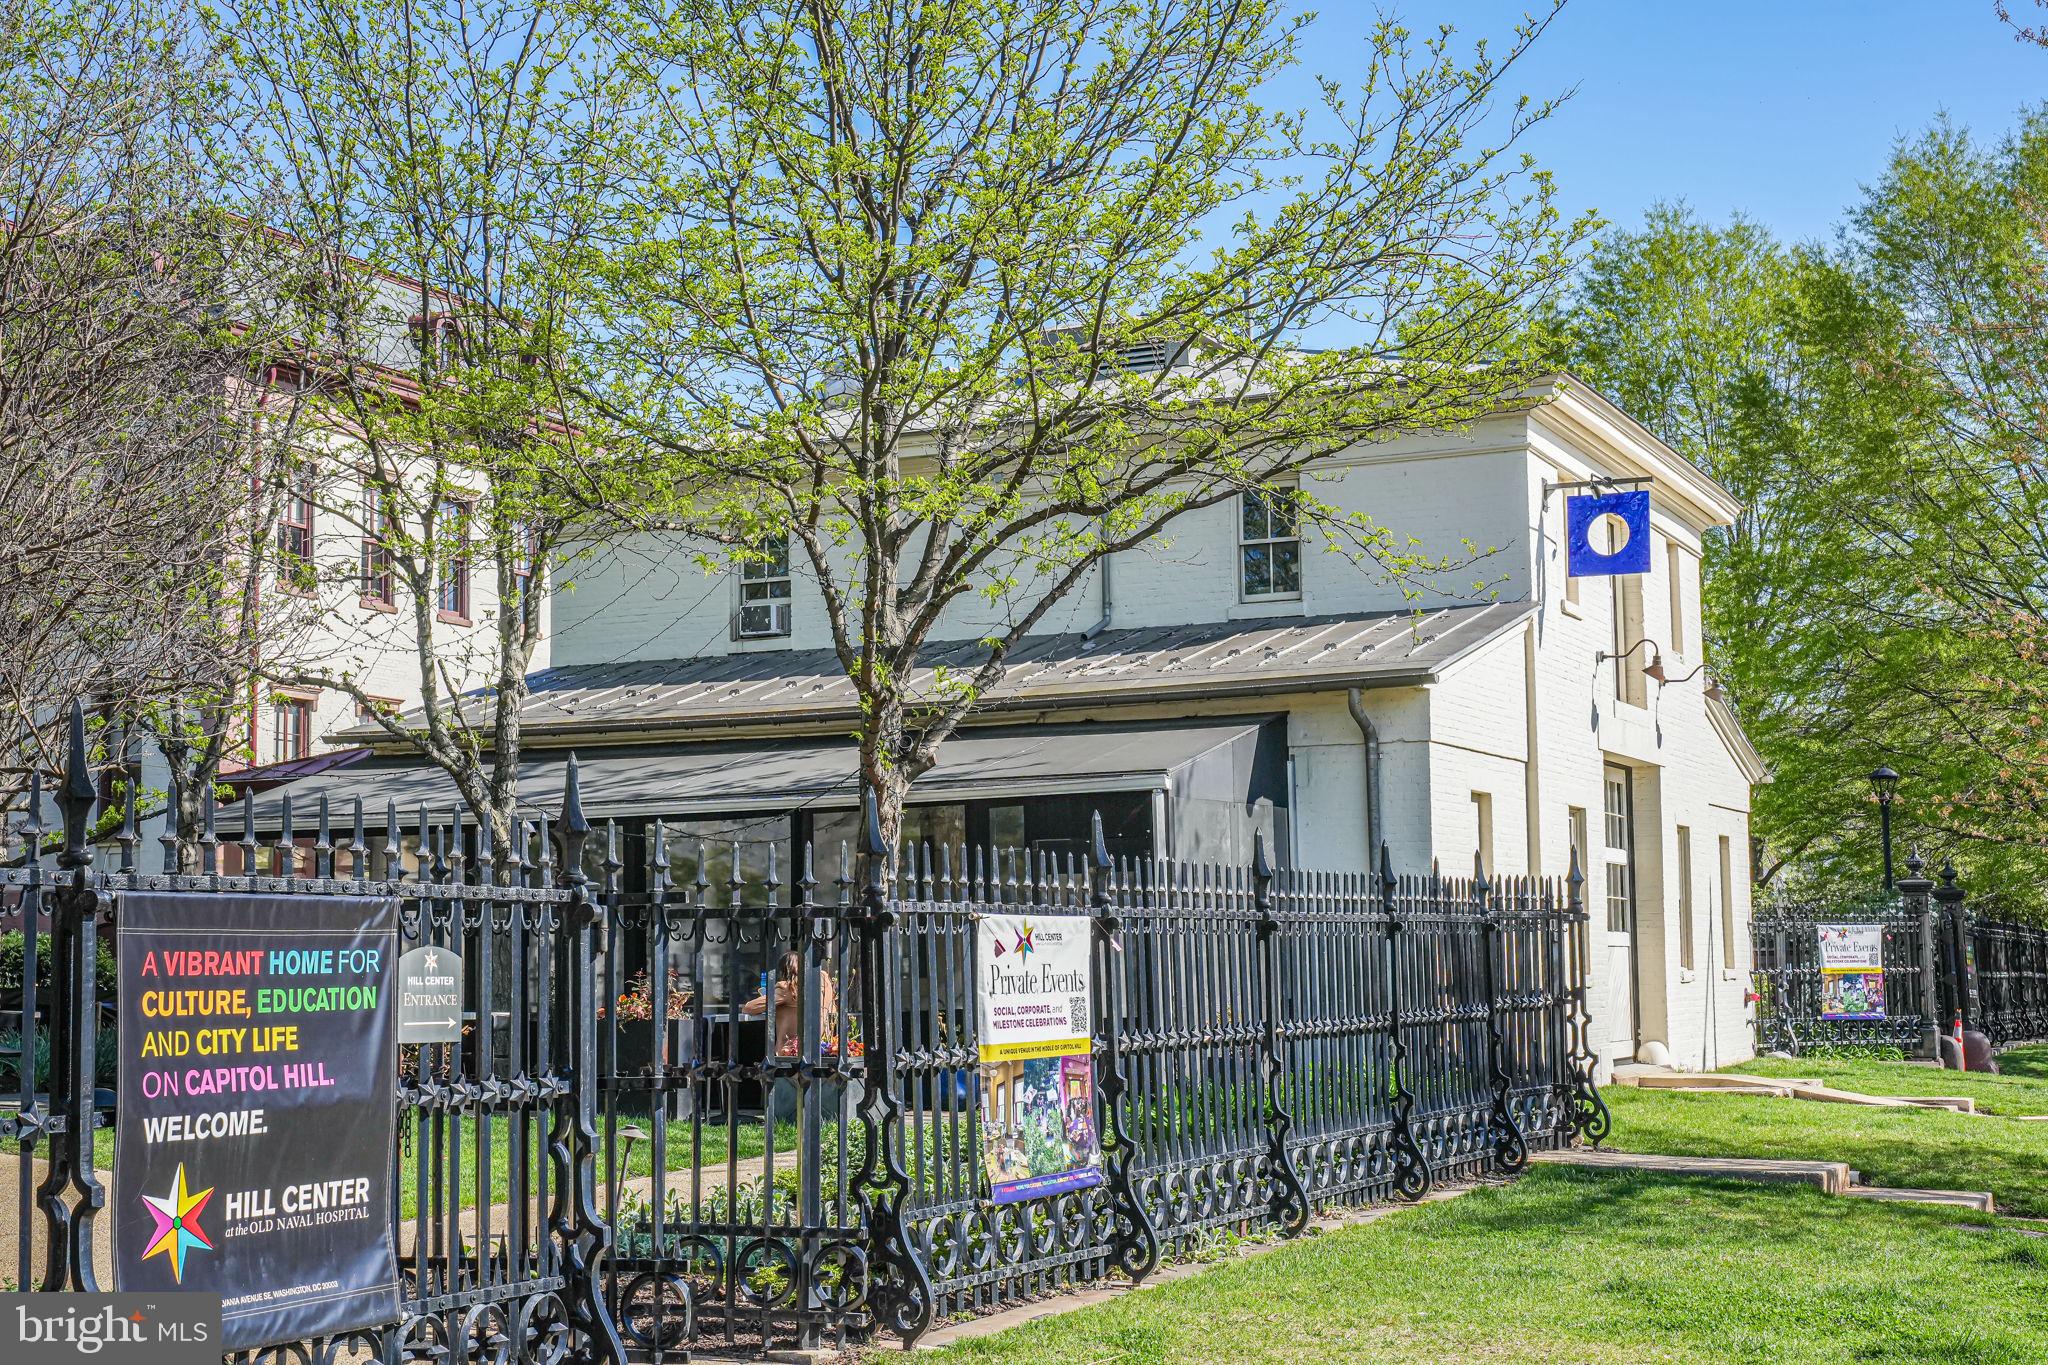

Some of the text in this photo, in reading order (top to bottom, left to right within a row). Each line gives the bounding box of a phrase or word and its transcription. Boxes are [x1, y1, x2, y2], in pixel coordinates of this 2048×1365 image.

[1035, 932, 1063, 941] HILL CENTER
[1825, 941, 1878, 953] Private Events
[142, 949, 380, 977] A VIBRANT HOME FOR
[407, 976, 454, 986] HILL CENTER
[990, 963, 1086, 997] Private Events
[141, 986, 377, 1019] CULTURE, EDUCATION
[403, 992, 458, 1007] ENTRANCE
[993, 1005, 1063, 1016] SOCIAL, CORPORATE, and
[993, 1017, 1068, 1029] MILESTONE CELEBRATIONS
[141, 1026, 299, 1058] AND CITY LIFE
[142, 1062, 335, 1098] ON CAPITOL HILL.
[143, 1109, 268, 1144] WELCOME.
[225, 1177, 370, 1221] HILL CENTER
[225, 1206, 370, 1238] at the OLD NAVAL HOSPITAL
[240, 1292, 263, 1304] AVENUE
[273, 1285, 313, 1298] WASHINGTON,
[312, 1283, 321, 1291] DC
